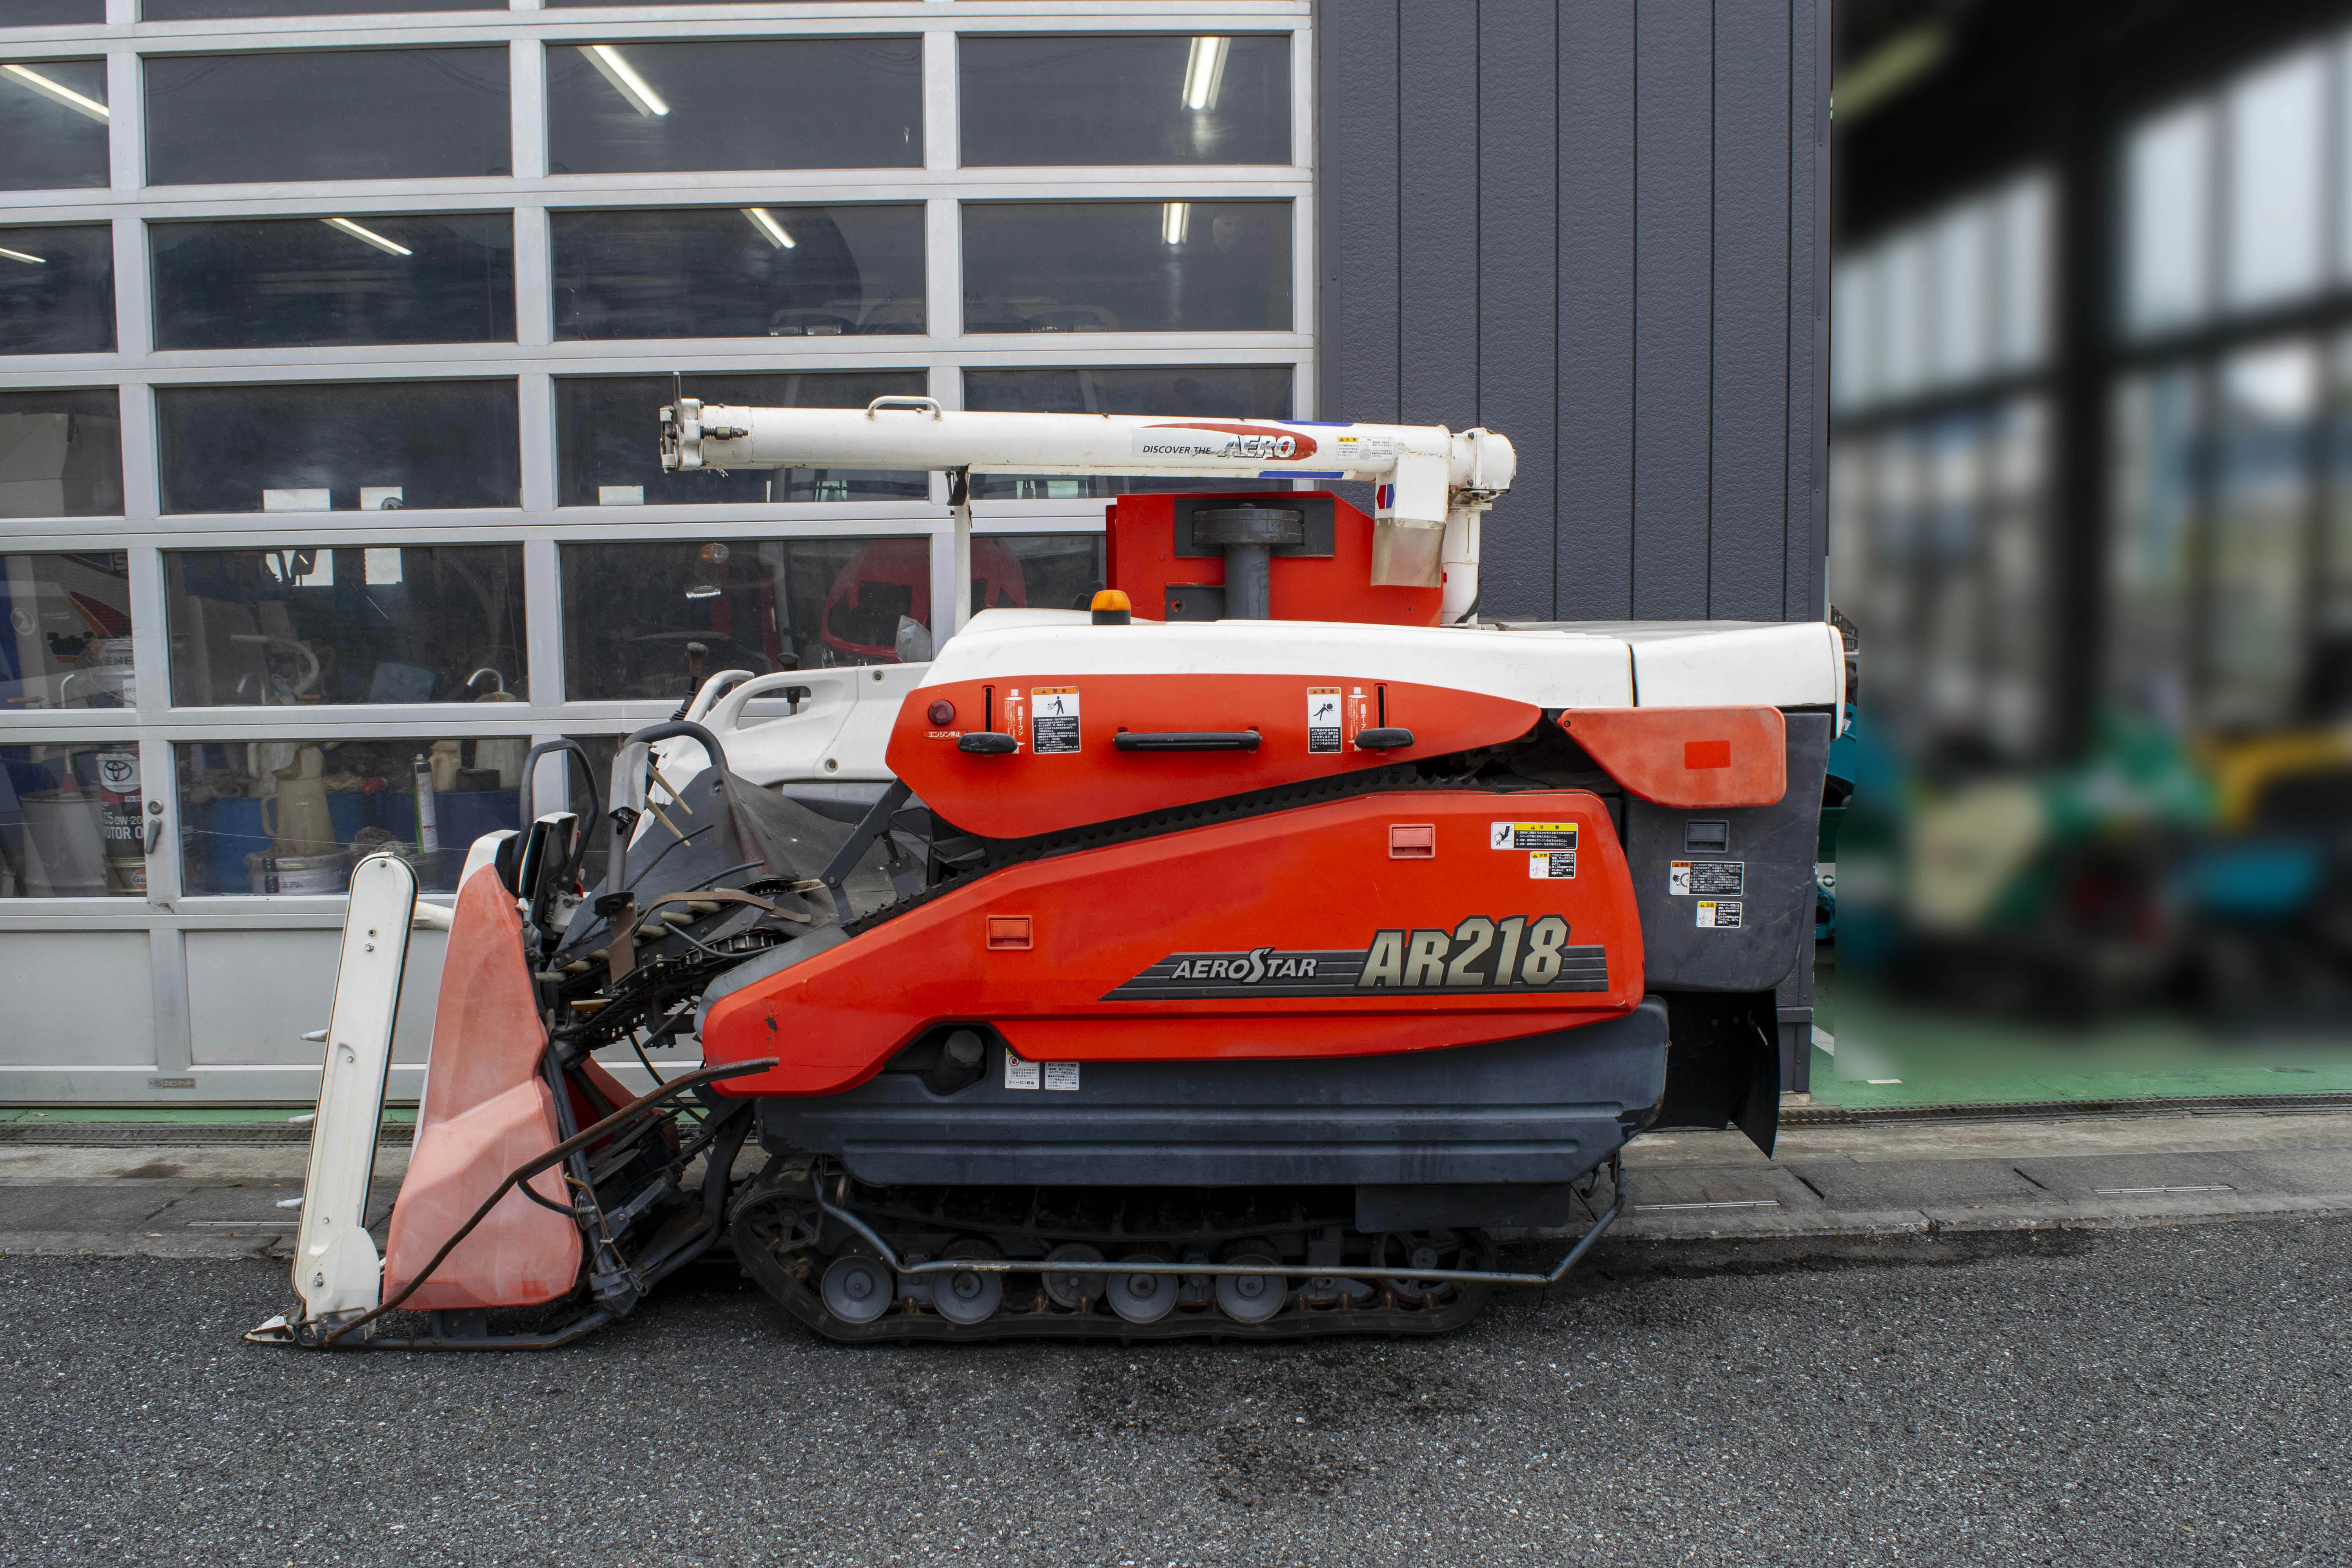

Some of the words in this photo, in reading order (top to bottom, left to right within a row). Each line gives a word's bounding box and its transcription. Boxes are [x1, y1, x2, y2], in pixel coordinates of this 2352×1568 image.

[1143, 445, 1190, 454] DISCOVER
[1194, 446, 1211, 455] THE
[1217, 435, 1296, 458] AERO
[106, 656, 133, 666] ENE
[106, 826, 132, 840] OTOR
[1358, 917, 1568, 987] AR218
